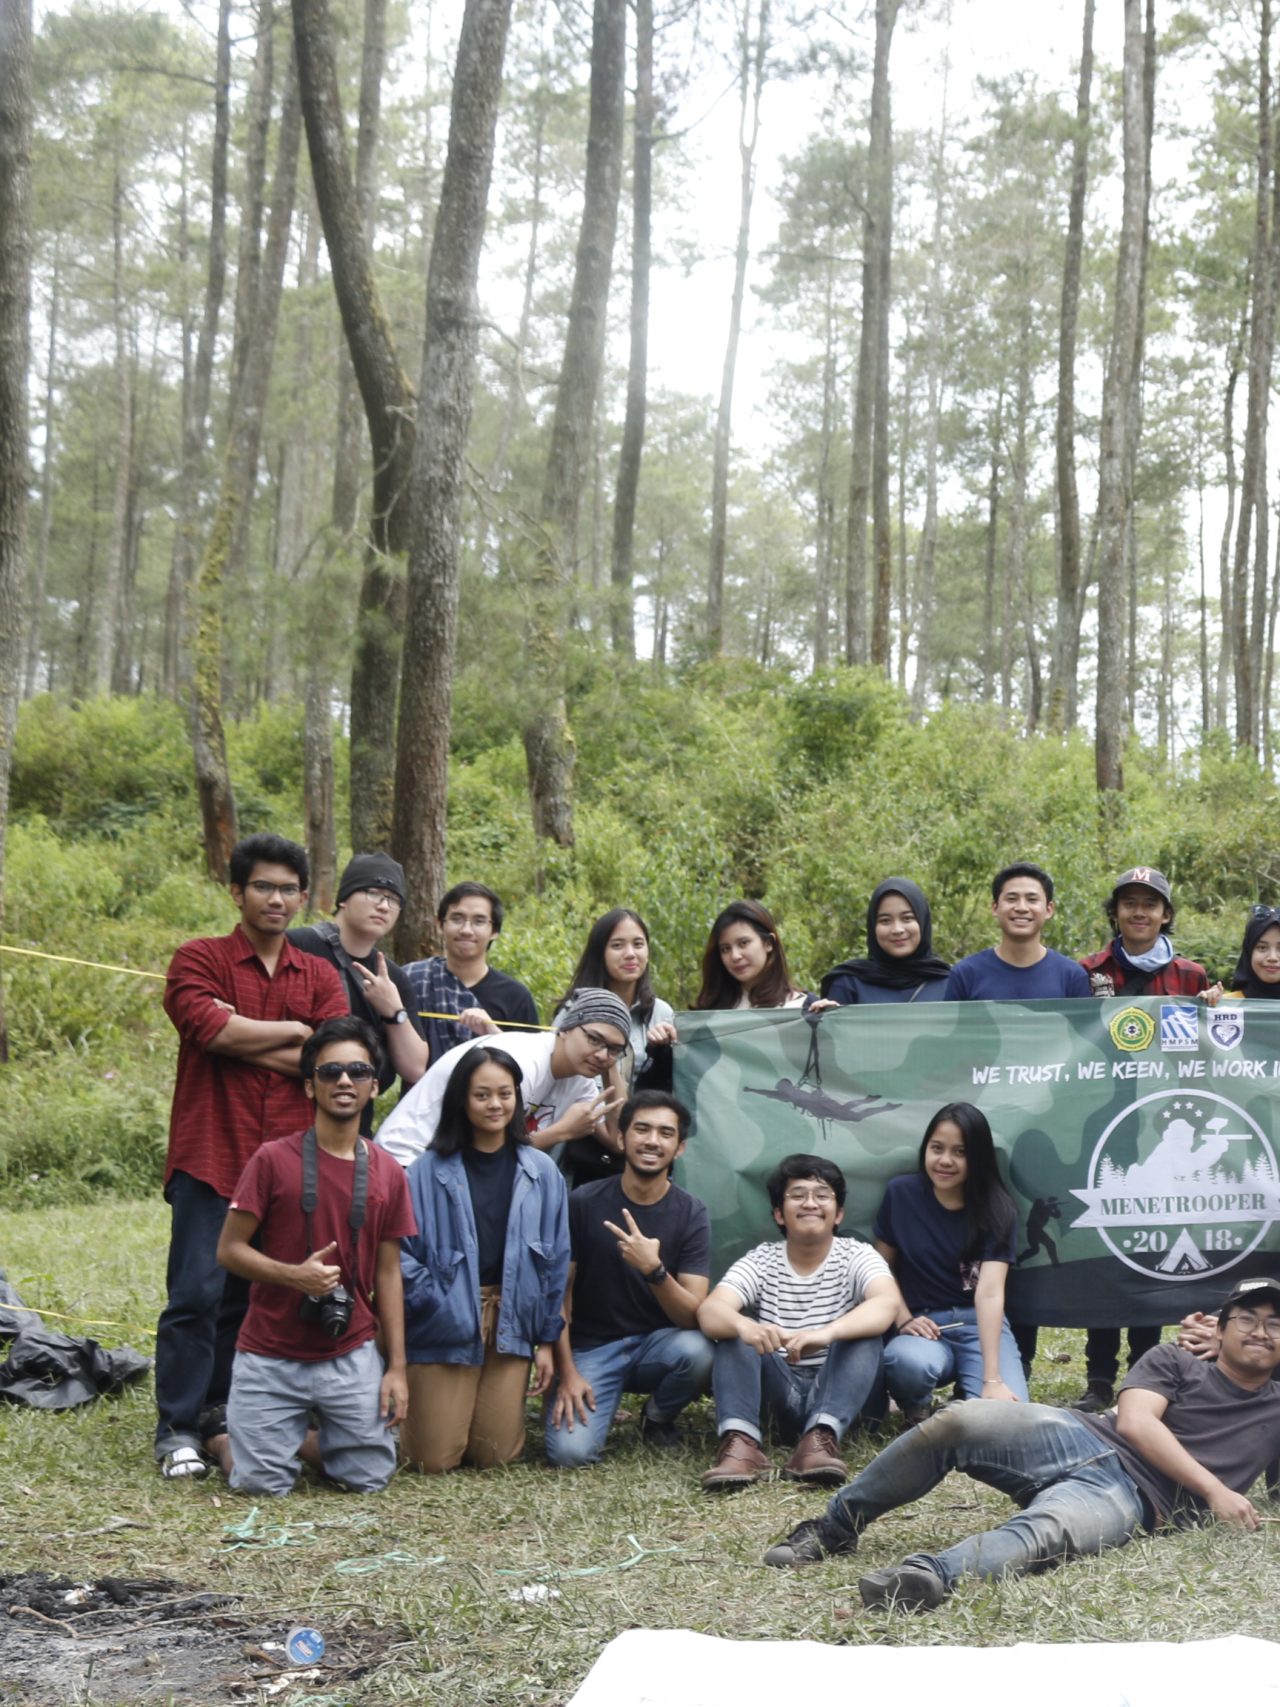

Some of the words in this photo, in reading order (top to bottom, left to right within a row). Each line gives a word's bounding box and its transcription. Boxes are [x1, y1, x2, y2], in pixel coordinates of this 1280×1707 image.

[1131, 868, 1152, 882] M
[1214, 1013, 1238, 1021] HRD
[972, 1066, 1000, 1084] WE
[1005, 1063, 1070, 1084] TRUST,
[1077, 1061, 1106, 1079] WE
[1112, 1061, 1170, 1080] KEEN,
[1178, 1059, 1206, 1078] WE
[1212, 1060, 1267, 1078] WORK
[1100, 1192, 1267, 1216] MENETROOPER
